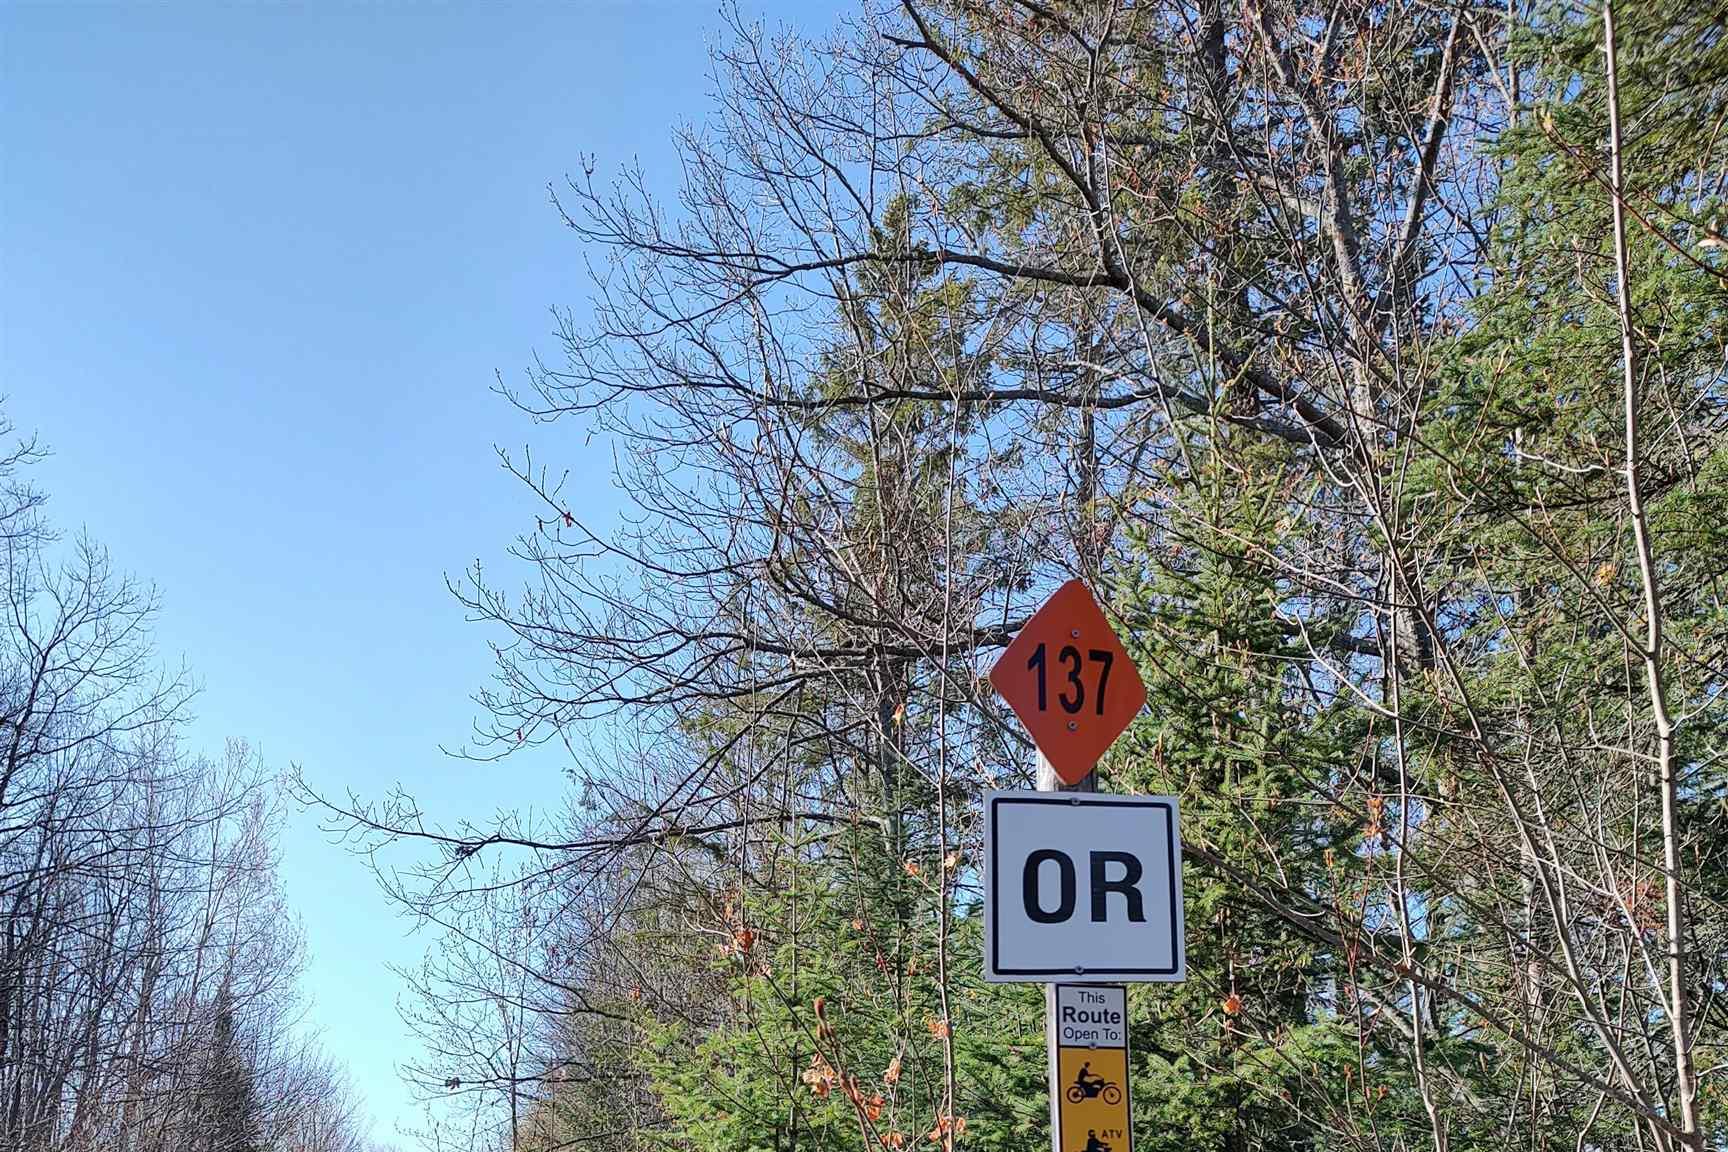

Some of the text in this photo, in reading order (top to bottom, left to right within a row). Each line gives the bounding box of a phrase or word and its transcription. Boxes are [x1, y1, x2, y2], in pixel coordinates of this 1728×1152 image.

[1026, 642, 1114, 716] 137
[1022, 849, 1147, 924] OR
[1078, 991, 1105, 1004] This
[1062, 1006, 1121, 1024] Route
[1063, 1026, 1122, 1041] Open To:
[1101, 1130, 1123, 1140] ATV
